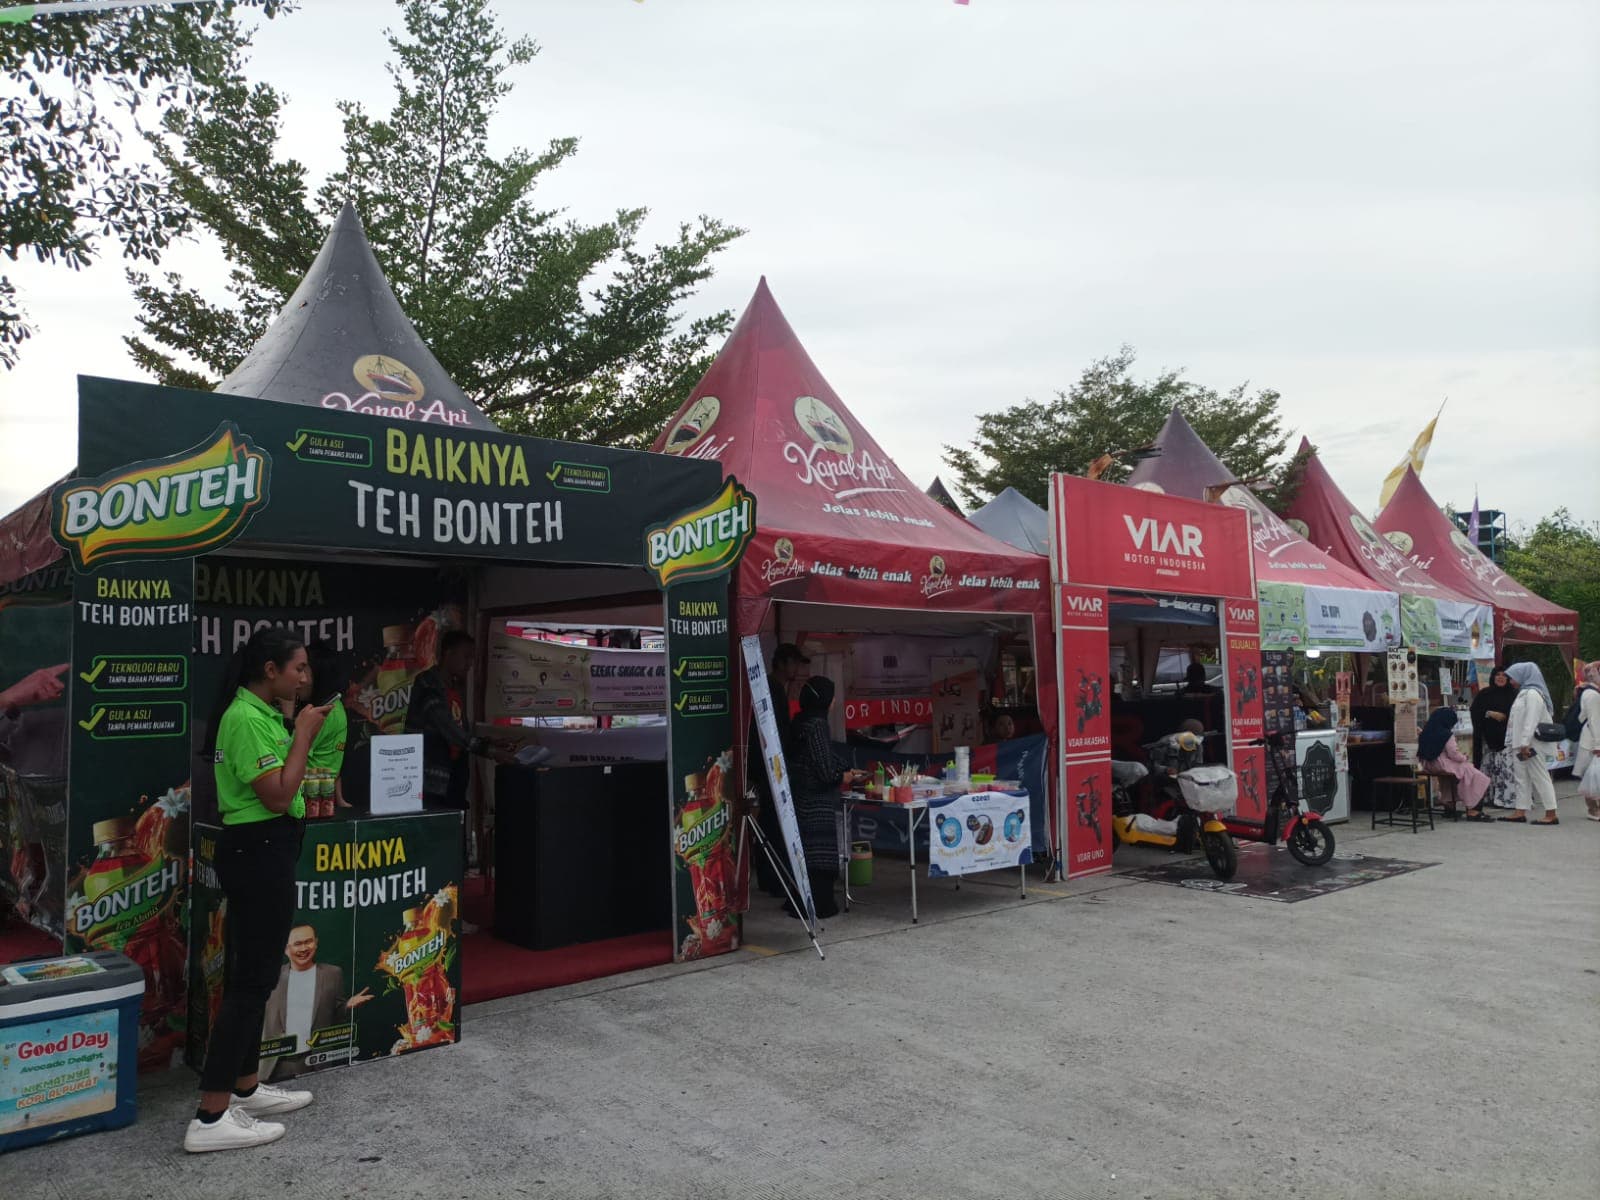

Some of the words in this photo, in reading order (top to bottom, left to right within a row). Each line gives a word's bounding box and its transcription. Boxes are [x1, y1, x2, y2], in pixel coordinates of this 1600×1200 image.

[310, 437, 328, 447] GULA
[330, 440, 344, 449] ASLI
[386, 428, 530, 487] BAIKNYA
[784, 441, 860, 491] Kapal
[857, 451, 896, 488] Api
[66, 456, 257, 535] BONTEH
[348, 480, 421, 538] TEH
[433, 498, 564, 545] BONTEH
[822, 503, 861, 516] Jelas
[864, 508, 900, 522] lebih
[650, 500, 749, 566] BONTEH
[1123, 514, 1204, 558] VIAR
[761, 559, 789, 581] Kapal
[810, 561, 844, 577] Jelas
[848, 566, 878, 580] lbih
[882, 570, 912, 583] enak
[959, 575, 986, 588] Jelas
[990, 576, 1013, 589] lebih
[1016, 577, 1040, 590] enak
[1124, 552, 1156, 565] MOTOR
[1160, 558, 1206, 571] INDONESIA
[97, 577, 172, 600] BAIKNYA
[196, 566, 324, 606] BAIKNYA
[78, 601, 114, 625] TEH
[119, 603, 189, 627] BONTEH
[679, 601, 719, 617] BAIKNYA
[1067, 595, 1103, 612] VIAR
[1229, 607, 1255, 620] VIAR
[670, 618, 689, 635] TEH
[692, 618, 727, 636] BONTEH
[109, 676, 127, 684] TANPA
[110, 663, 157, 673] TEKNOLOGI
[157, 662, 181, 673] BARU
[107, 723, 126, 731] TANPA
[109, 710, 131, 721] GULA
[133, 709, 151, 720] ASLI
[679, 803, 730, 853] BONTEH
[315, 837, 406, 872] BAIKNYA
[75, 860, 179, 933] BONTEH
[295, 881, 336, 911] TEH
[343, 867, 427, 909] BONTEH
[394, 931, 445, 974] BONTEH
[18, 1035, 68, 1060] Good
[72, 1031, 109, 1049] Day
[20, 1060, 66, 1074] Avocado
[67, 1052, 103, 1065] Delight
[17, 1094, 46, 1109] KOPI
